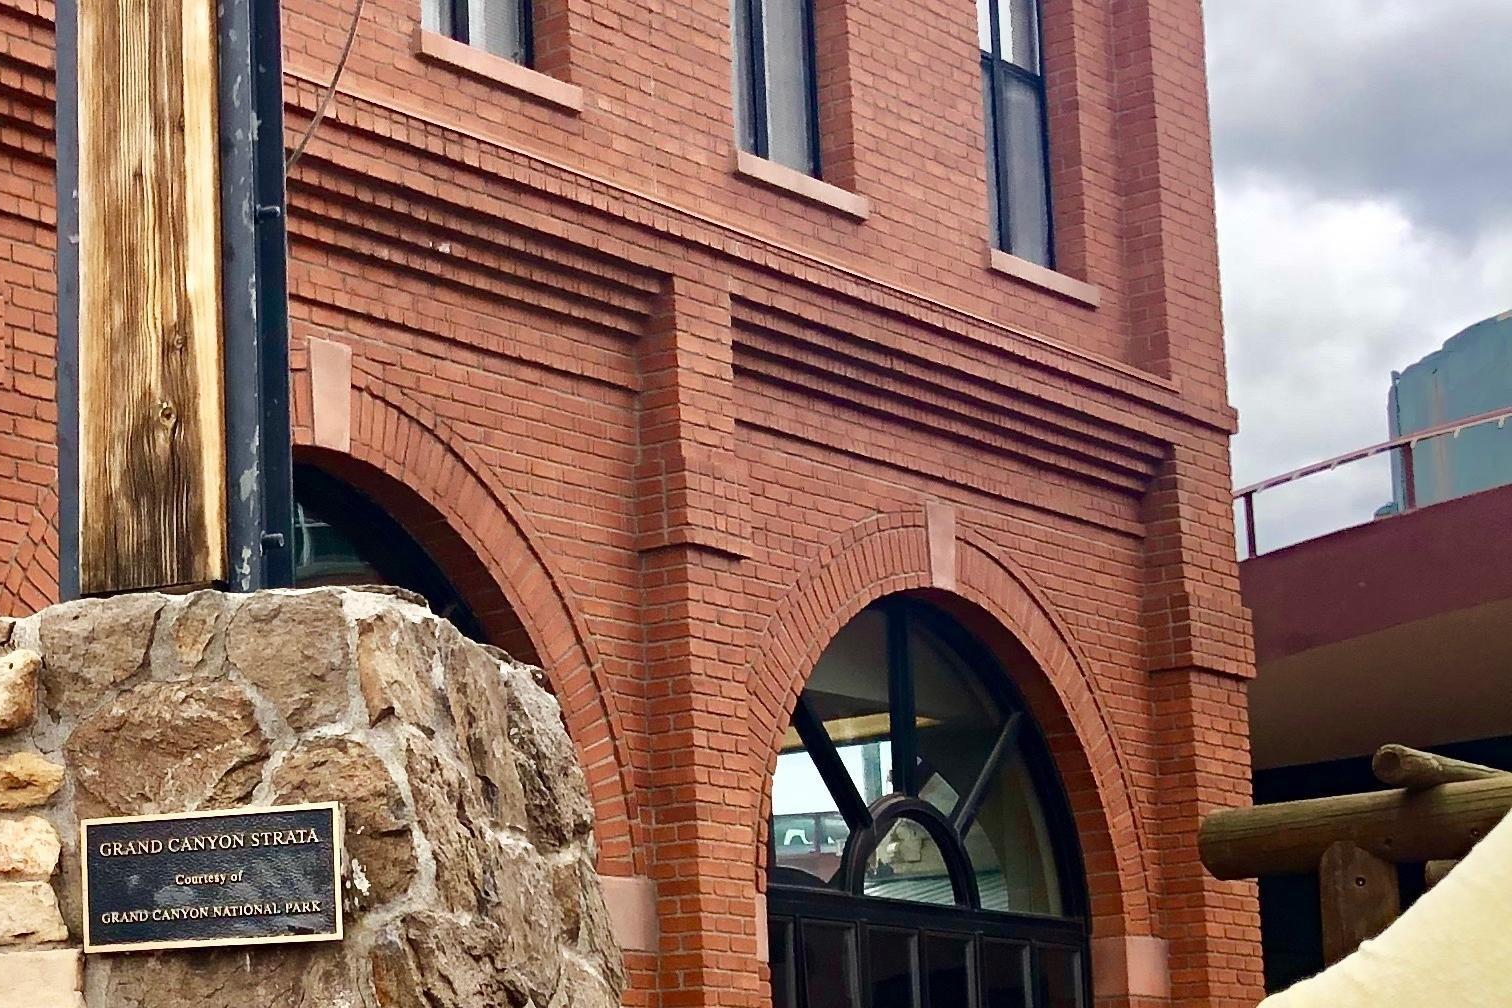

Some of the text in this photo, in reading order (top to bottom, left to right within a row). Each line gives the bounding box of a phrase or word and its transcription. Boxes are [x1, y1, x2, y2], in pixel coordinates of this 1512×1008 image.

[100, 827, 319, 857] GRAND CANYON STRATA
[175, 870, 243, 885] Courtesy of
[101, 900, 321, 924] GRAND CANYON NATIONAL PARK
